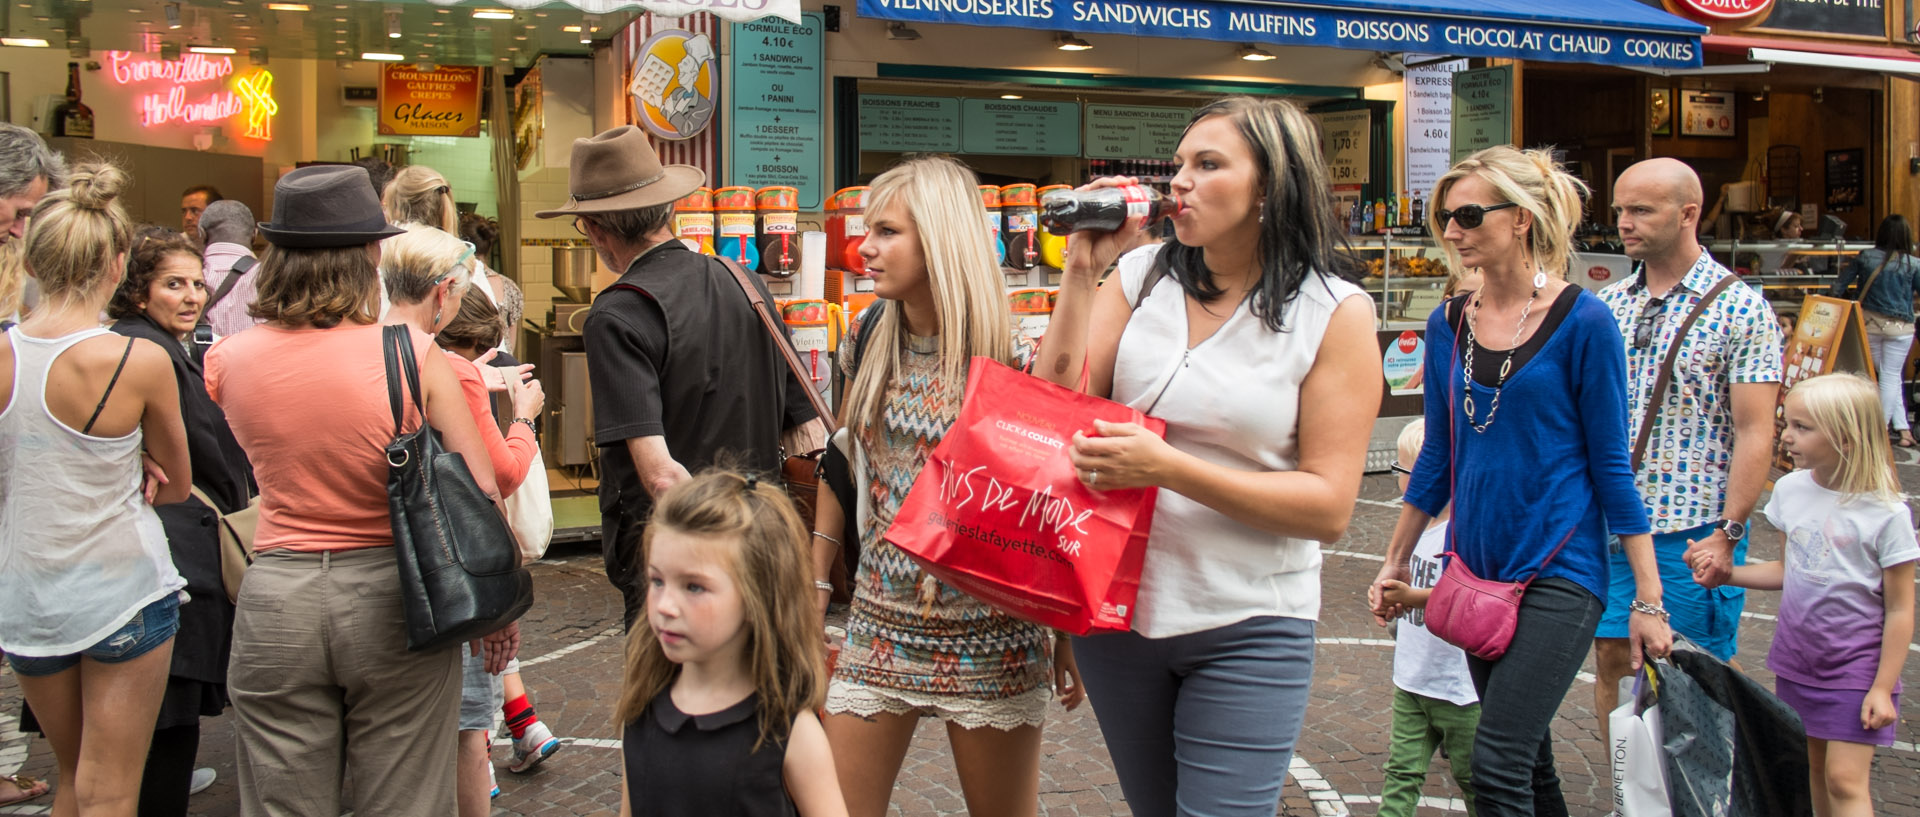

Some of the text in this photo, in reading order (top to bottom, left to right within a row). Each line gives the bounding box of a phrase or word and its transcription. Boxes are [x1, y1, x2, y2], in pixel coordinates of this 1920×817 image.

[742, 23, 813, 36] FORMULE ÉCO
[1072, 2, 1212, 28] SANDWICHS
[1228, 12, 1316, 36] MUFFINS
[1336, 20, 1429, 42] BOISSONS
[1444, 26, 1544, 50] CHOCOLAT
[1549, 34, 1610, 54] CHAUD
[1624, 38, 1694, 60] COOKIES
[759, 54, 802, 64] SANDWICH
[392, 72, 472, 82] CROUSTILLONS
[1415, 76, 1452, 86] EXPRESS
[406, 81, 456, 91] GAUFRES
[768, 95, 794, 103] PANINI
[394, 102, 464, 124] Glaces
[762, 126, 799, 134] DESSERT
[1333, 138, 1351, 152] 1,70
[762, 165, 798, 173] BOISSON
[1333, 167, 1350, 180] 1,50
[1399, 338, 1416, 346] Coca-Cola
[996, 420, 1021, 434] CLICK
[1028, 432, 1064, 449] COLLECT
[981, 477, 1020, 512] De
[1018, 484, 1093, 535] MoDe
[928, 510, 1074, 572] galerieslafayette.com
[1056, 535, 1081, 557] SUR
[1412, 554, 1438, 588] THE
